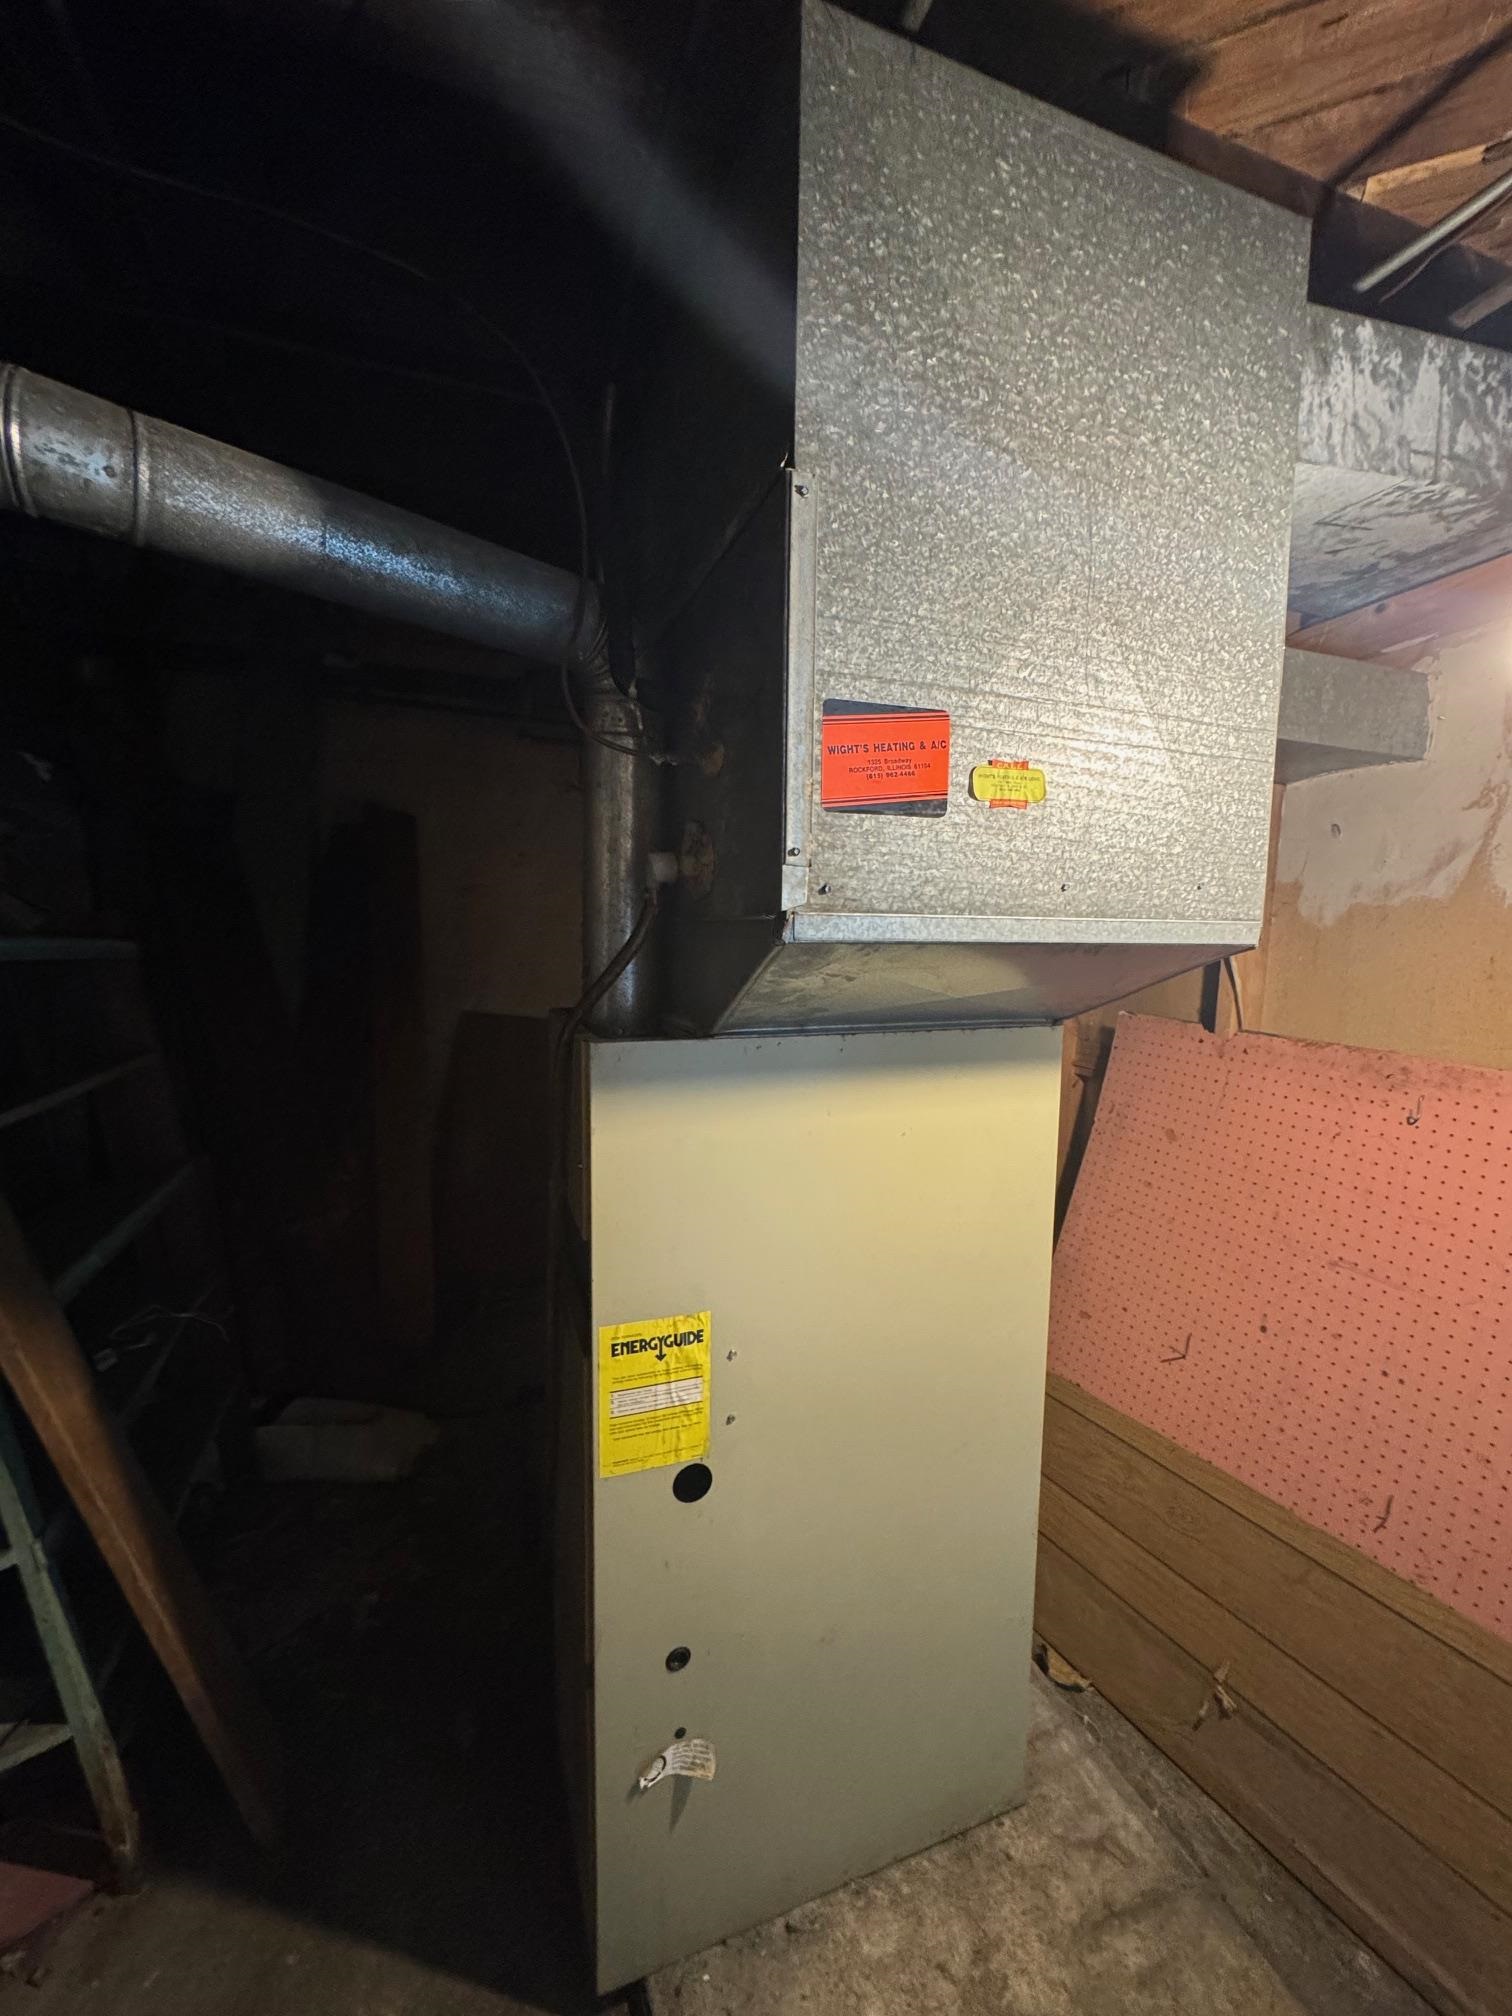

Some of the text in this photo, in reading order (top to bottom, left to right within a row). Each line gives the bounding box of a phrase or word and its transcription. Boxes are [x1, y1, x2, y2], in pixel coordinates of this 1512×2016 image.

[827, 740, 947, 755] WIGHT'S HEATING & A/C
[611, 1329, 704, 1360] ENERGYGUIDE
